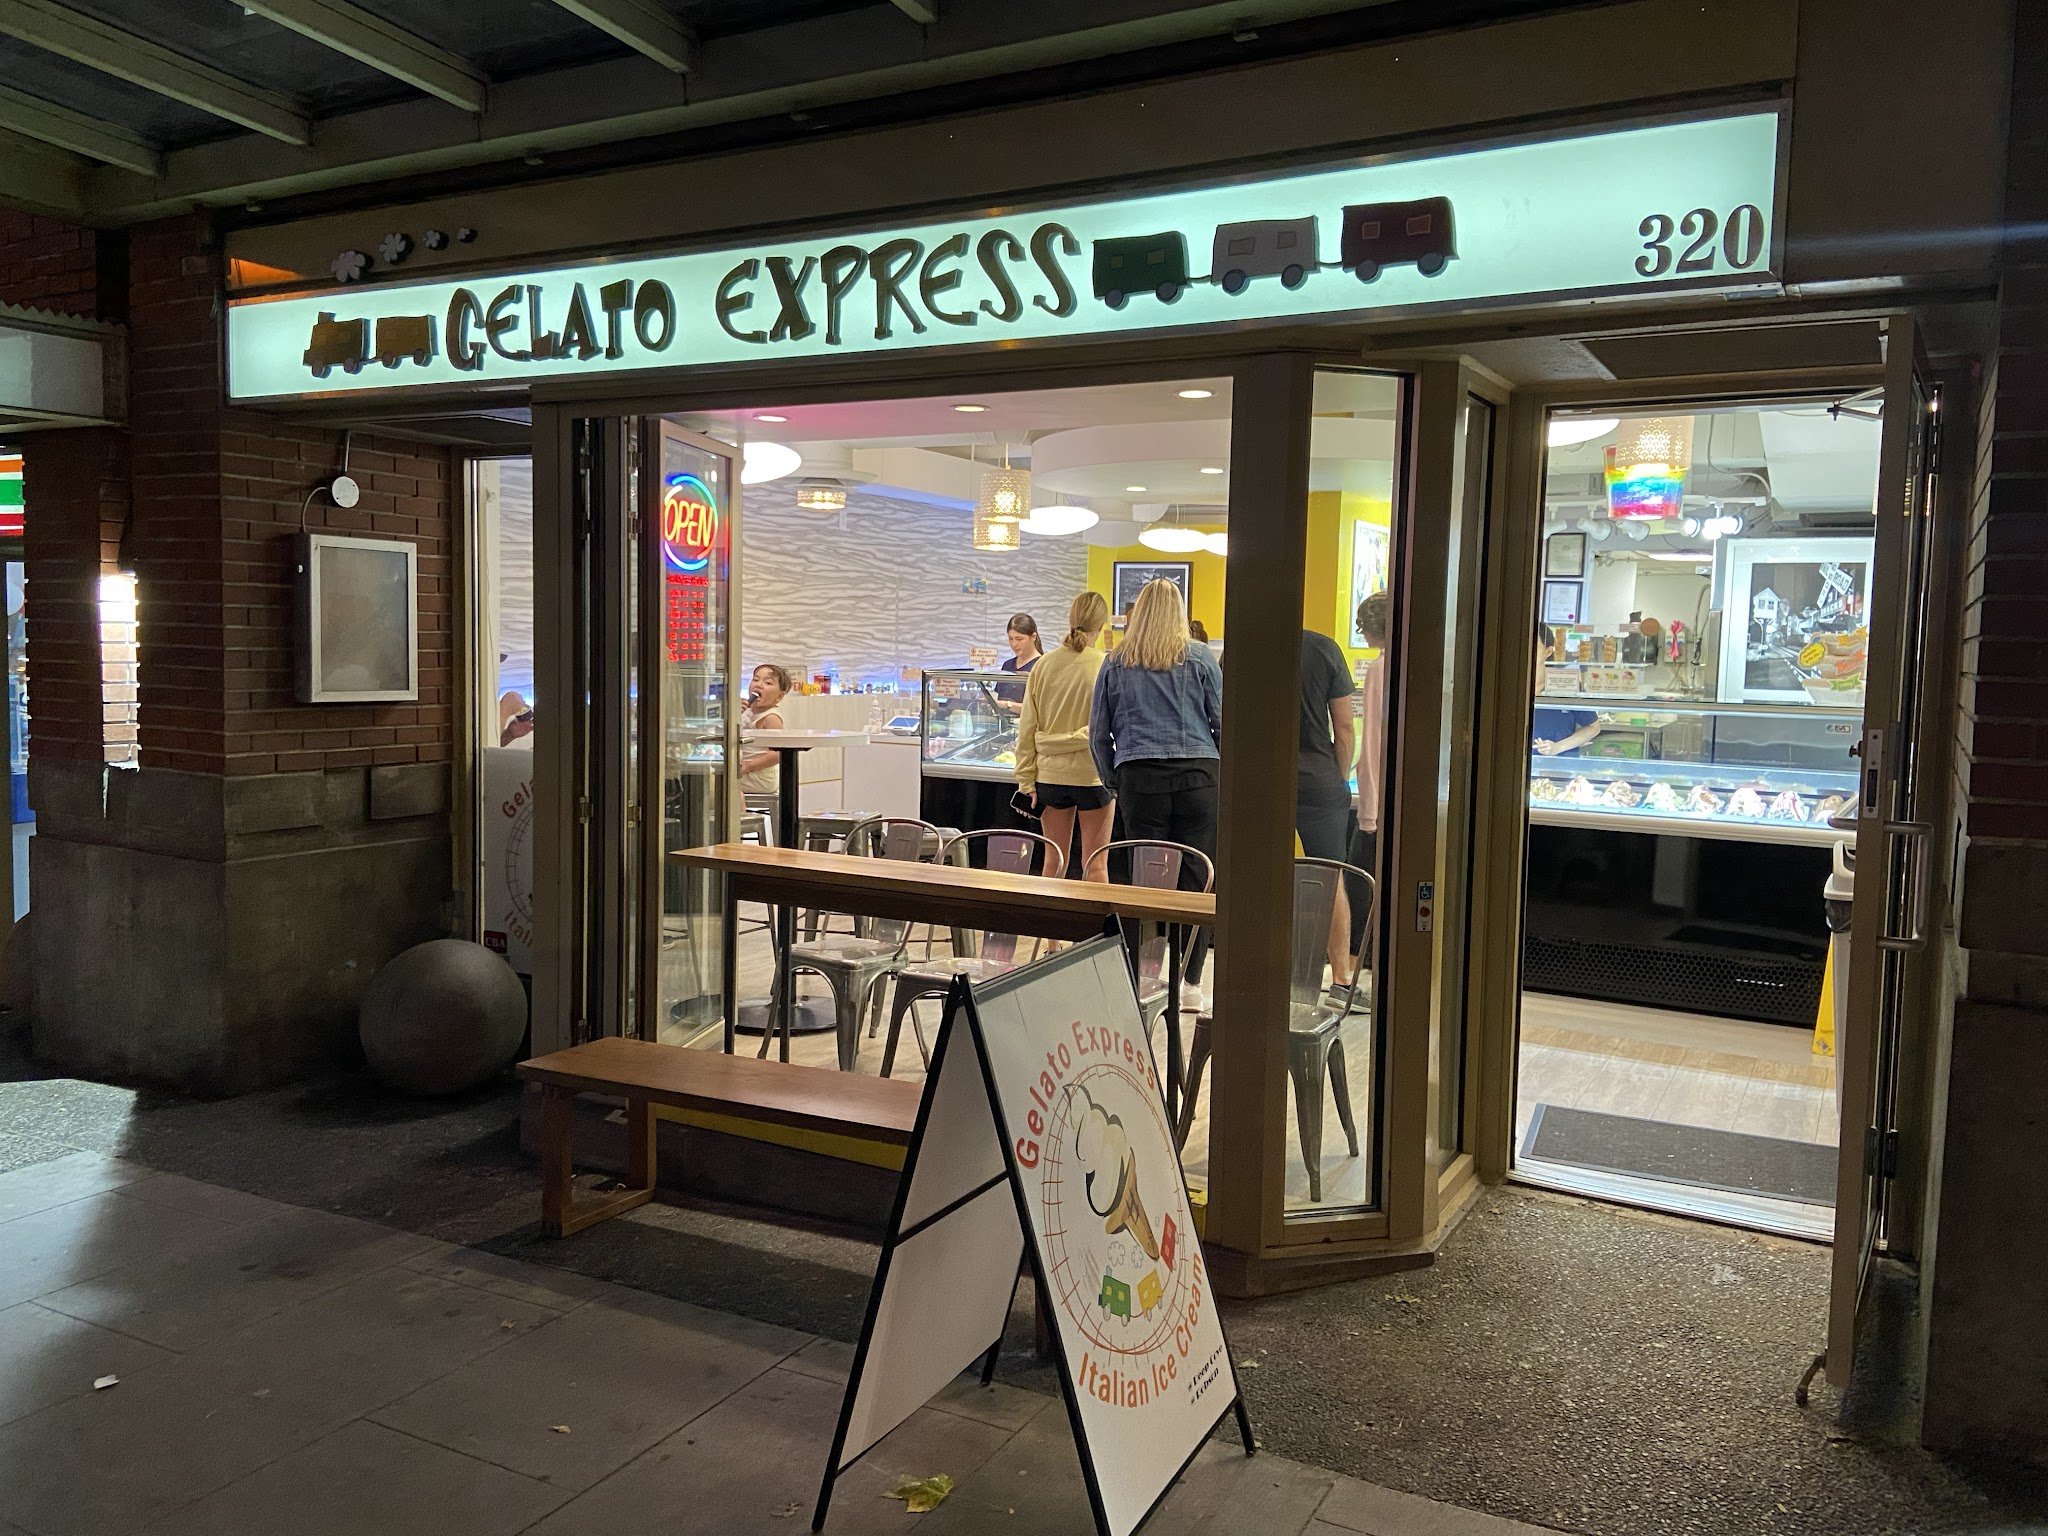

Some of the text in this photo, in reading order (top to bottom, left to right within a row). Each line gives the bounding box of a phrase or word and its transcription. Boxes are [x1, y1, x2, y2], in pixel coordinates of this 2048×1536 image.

[446, 222, 1082, 371] GELATO EXPRESS
[1634, 204, 1765, 277] 320
[664, 498, 714, 548] OPEN
[1016, 1020, 1155, 1169] Gelato Express
[1078, 1252, 1202, 1408] Italian Ice Cream
